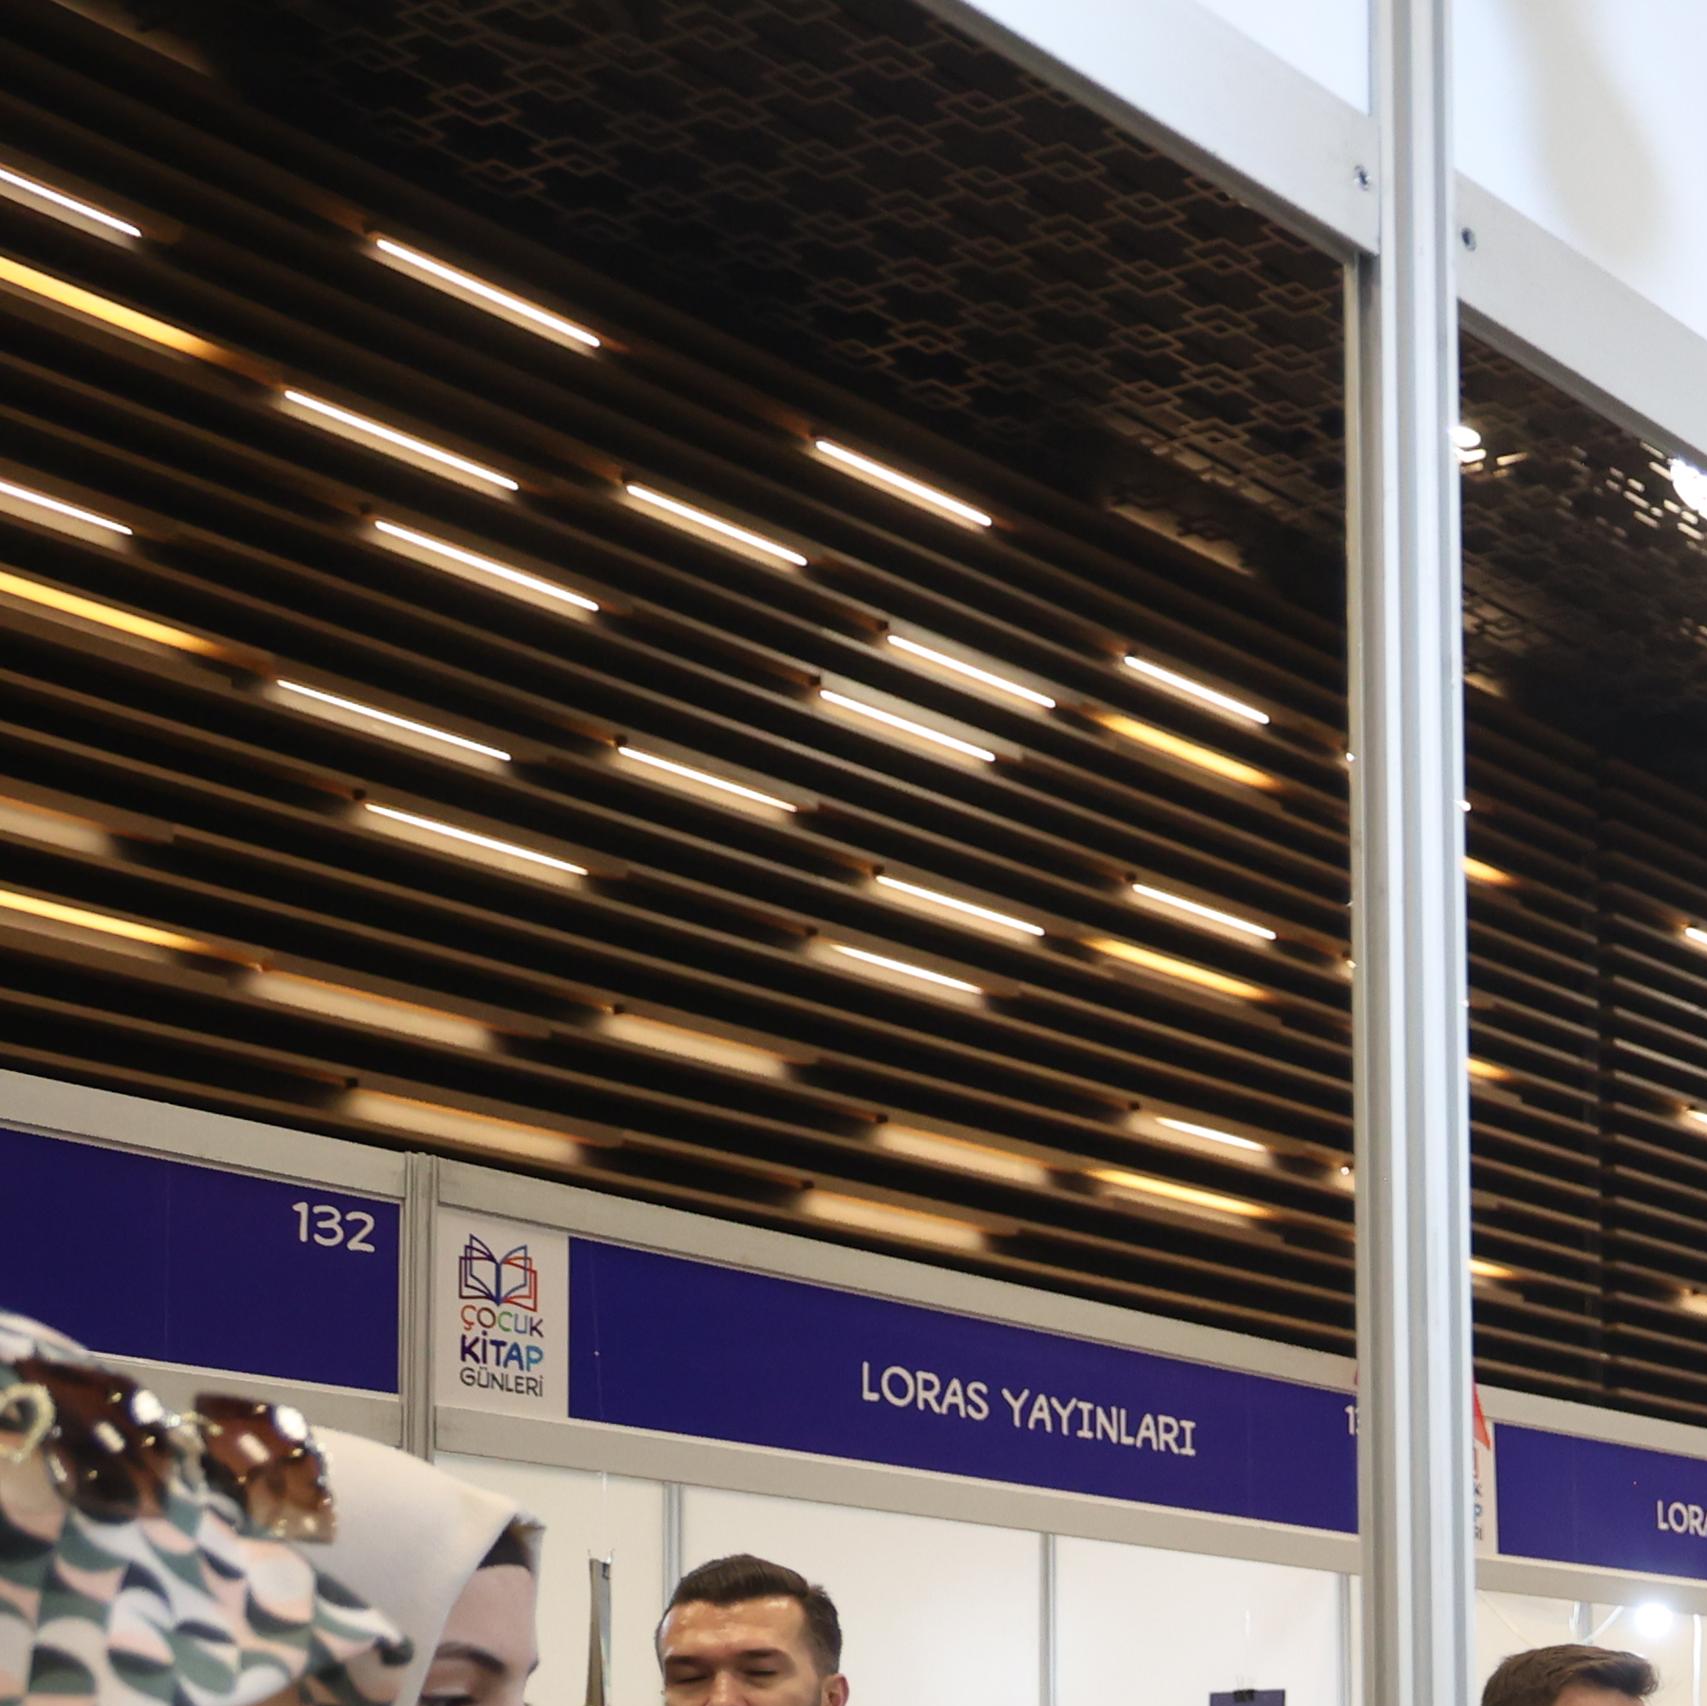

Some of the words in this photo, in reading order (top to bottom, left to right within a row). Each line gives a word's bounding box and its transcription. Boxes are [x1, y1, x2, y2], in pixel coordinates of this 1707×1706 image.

[292, 1201, 376, 1253] 132
[460, 1304, 544, 1338] ÇOCUK
[460, 1330, 544, 1372] KİTAP
[460, 1366, 544, 1397] GÜNLERİ
[861, 1361, 989, 1421] LORAS
[1002, 1388, 1197, 1457] YAYINLARI
